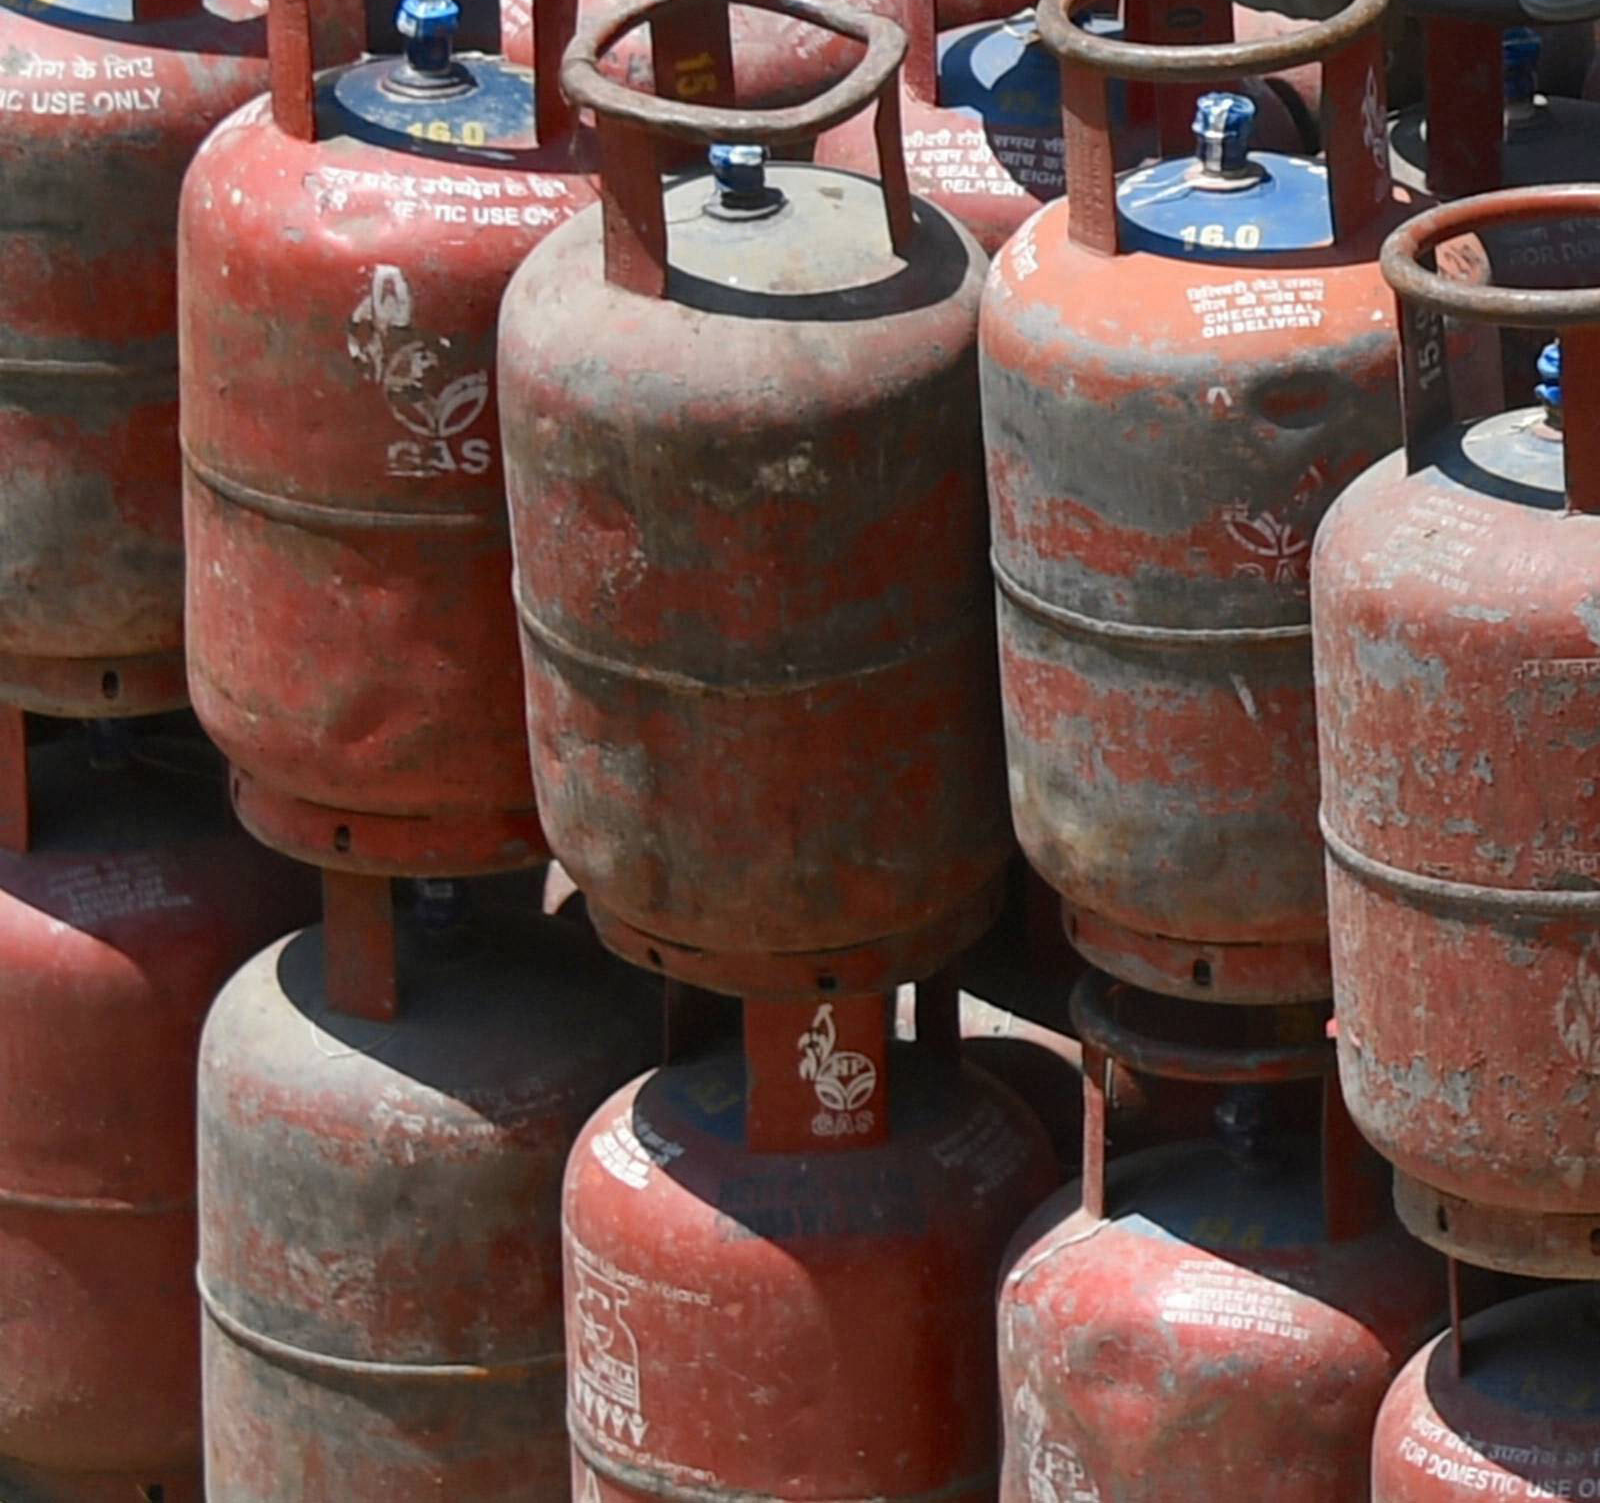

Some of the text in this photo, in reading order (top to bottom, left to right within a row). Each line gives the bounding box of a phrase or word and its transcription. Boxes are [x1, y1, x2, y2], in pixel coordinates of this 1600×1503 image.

[32, 87, 161, 114] USE ONLY
[473, 207, 518, 225] USE
[1180, 224, 1260, 251] 16.0
[1201, 311, 1322, 339] ON DELIVERY
[1204, 307, 1268, 326] CHECK
[1399, 1437, 1428, 1470] FOR
[1425, 1449, 1522, 1499] DOMESTIC
[1525, 1475, 1573, 1500] USE
